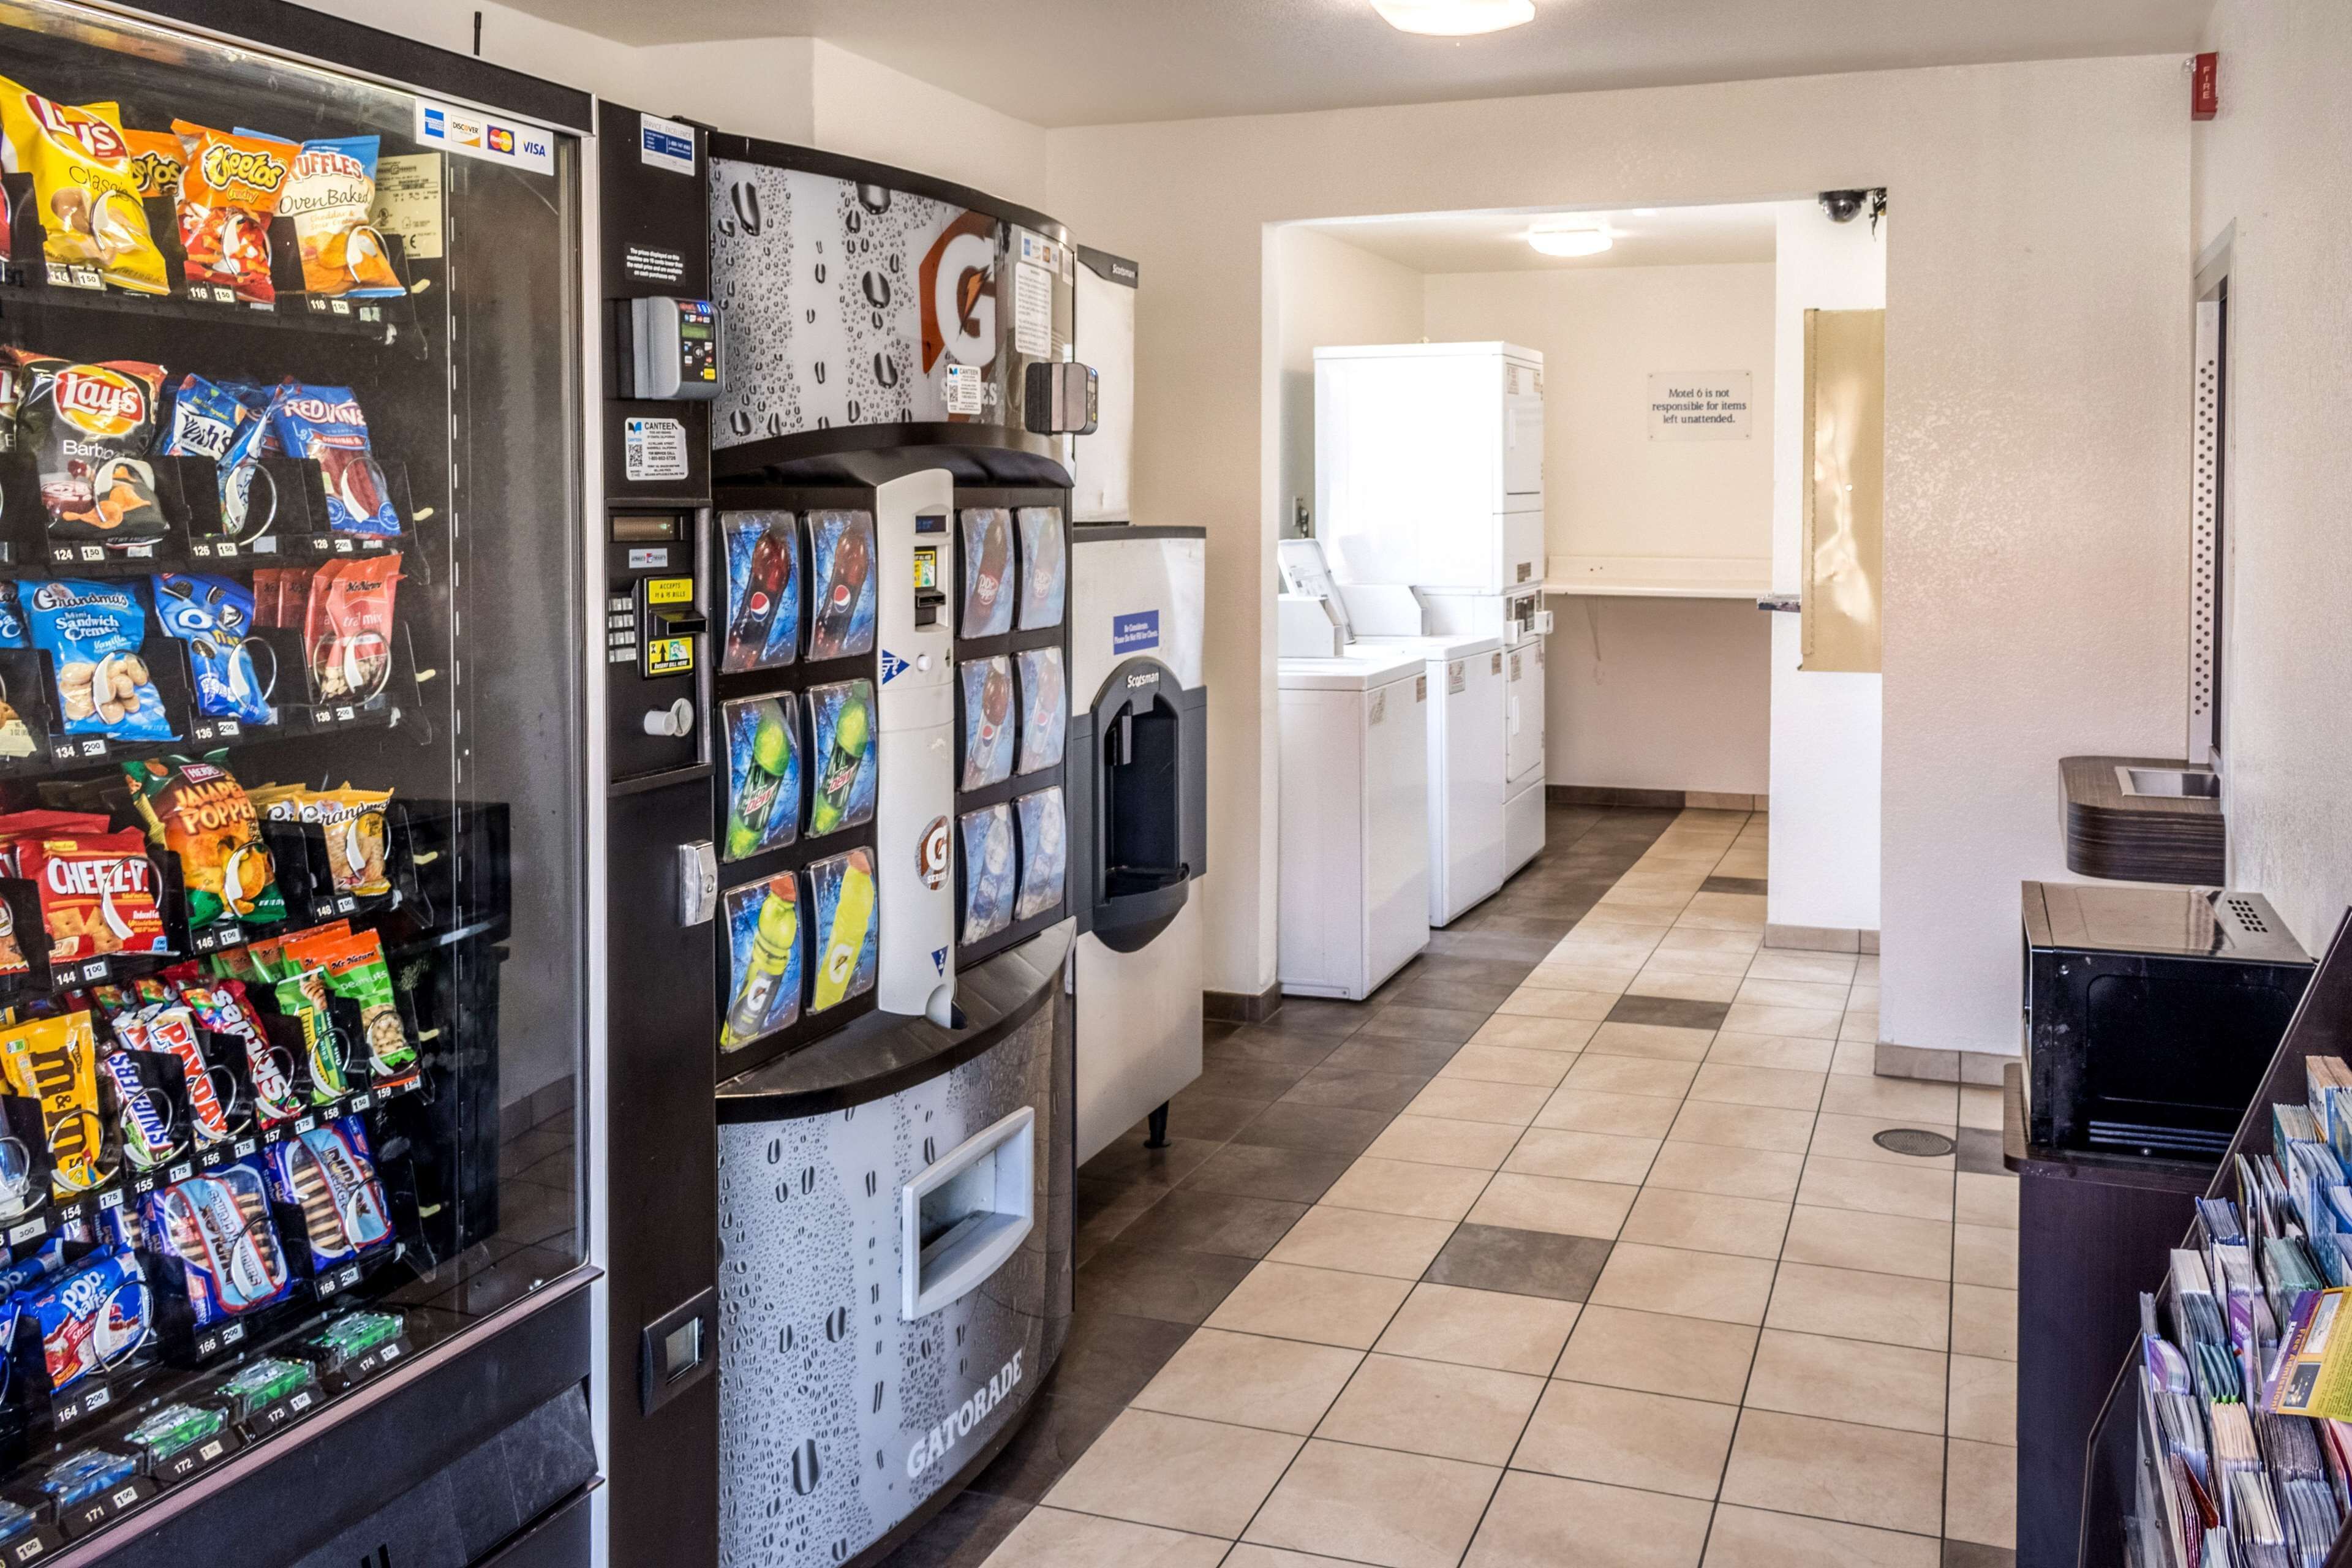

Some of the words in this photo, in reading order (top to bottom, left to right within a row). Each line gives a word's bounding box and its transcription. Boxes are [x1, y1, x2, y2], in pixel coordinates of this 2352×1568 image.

[453, 122, 478, 134] DISCOVER
[523, 140, 546, 157] VISA
[205, 146, 286, 189] Cheetos
[69, 165, 130, 202] Classic
[227, 187, 259, 203] Crunchy
[279, 195, 326, 214] Oven
[327, 184, 371, 206] Baked
[189, 286, 206, 299] 116
[311, 299, 325, 309] 118
[63, 373, 138, 417] Lay's
[1668, 388, 1694, 398] Motel
[1697, 389, 1703, 398] 6
[1705, 388, 1713, 398] is
[1716, 389, 1730, 398] not
[1652, 401, 1704, 413] responsible
[1706, 401, 1719, 410] for
[1721, 401, 1747, 410] items
[1664, 414, 1678, 423] left
[1681, 413, 1735, 424] unattended.
[193, 546, 210, 556] 126
[314, 540, 328, 549] 128
[53, 549, 74, 560] 124
[32, 587, 129, 611] Grandma's
[56, 614, 120, 630] Sandwich
[363, 612, 383, 624] mix
[1127, 672, 1159, 688] Scotsman
[315, 711, 331, 722] 138
[195, 728, 213, 738] 136
[56, 747, 75, 758] 134
[927, 872, 948, 883] SERIES
[317, 906, 332, 916] 148
[196, 937, 214, 949] 146
[347, 951, 375, 964] Nature
[57, 972, 76, 985] 144
[341, 970, 388, 989] peanuts
[211, 989, 292, 1102] Skittles
[110, 1052, 170, 1147] SNICKERS
[377, 1088, 392, 1099] 159
[323, 1108, 339, 1120] 158
[264, 1130, 280, 1143] 157
[202, 1153, 220, 1166] 156
[134, 1178, 153, 1193] 155
[61, 1205, 81, 1219] 154
[320, 1281, 336, 1295] 168
[74, 1288, 108, 1321] tarts
[199, 1336, 216, 1354] 166
[2293, 1327, 2306, 1351] Free
[360, 1357, 375, 1371] 174
[2271, 1354, 2296, 1410] Admission!
[59, 1404, 78, 1422] 164
[268, 1409, 285, 1422] 173
[907, 1348, 1023, 1479] GATORADE
[174, 1458, 194, 1475] 172
[85, 1506, 105, 1523] 171
